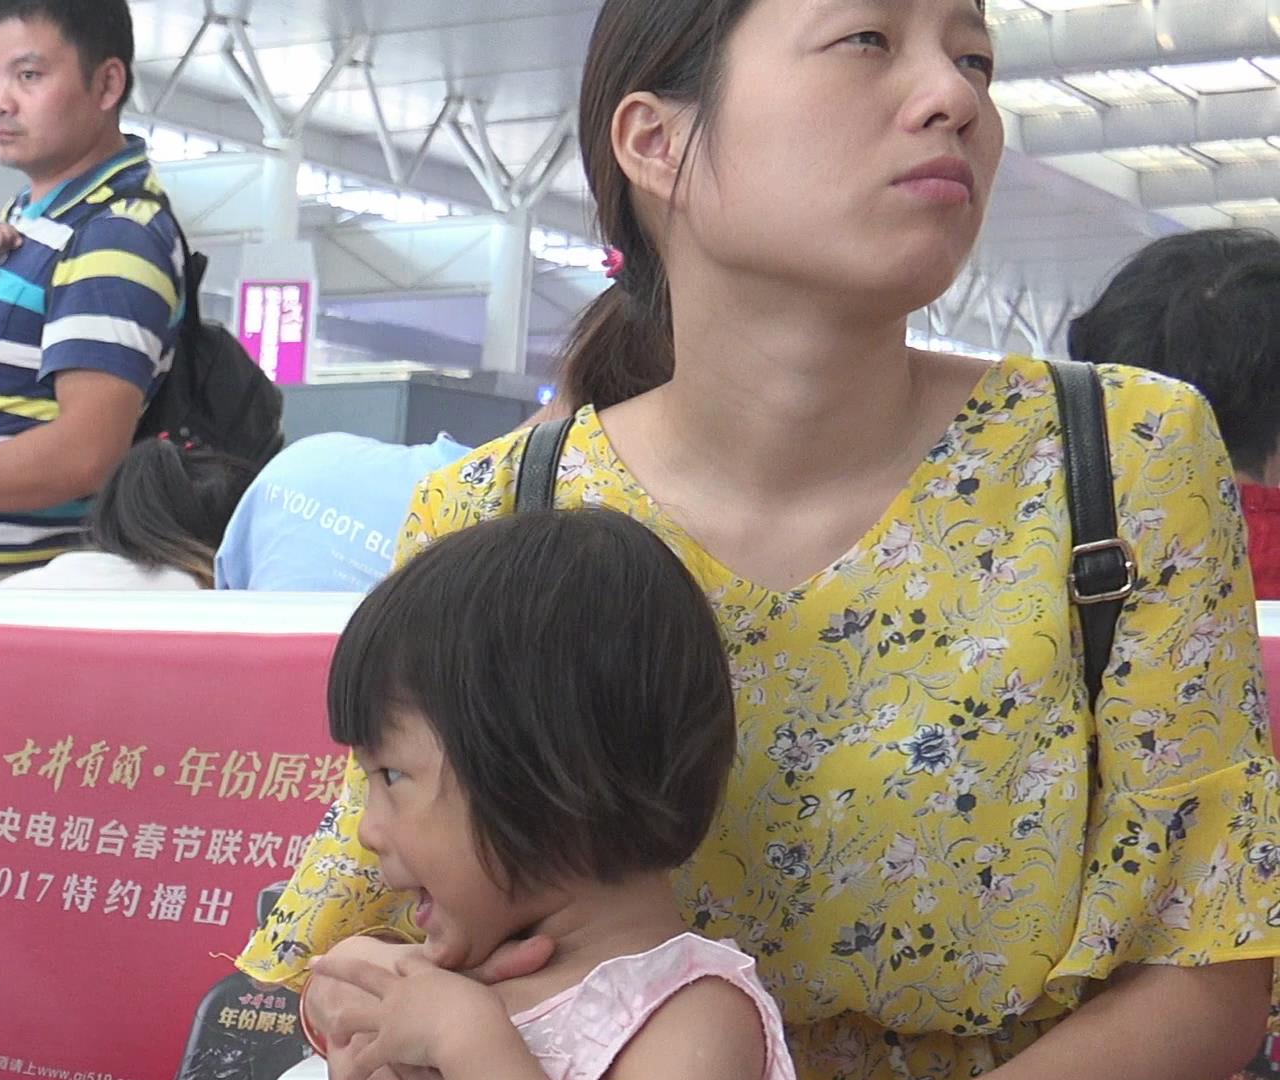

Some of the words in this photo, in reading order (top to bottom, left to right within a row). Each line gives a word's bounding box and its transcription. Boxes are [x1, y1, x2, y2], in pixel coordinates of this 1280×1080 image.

[264, 482, 281, 503] IF
[282, 487, 321, 521] YOU
[319, 506, 366, 543] GOT
[61, 873, 234, 927] 特约播出
[217, 1006, 298, 1036] 年份原浆
